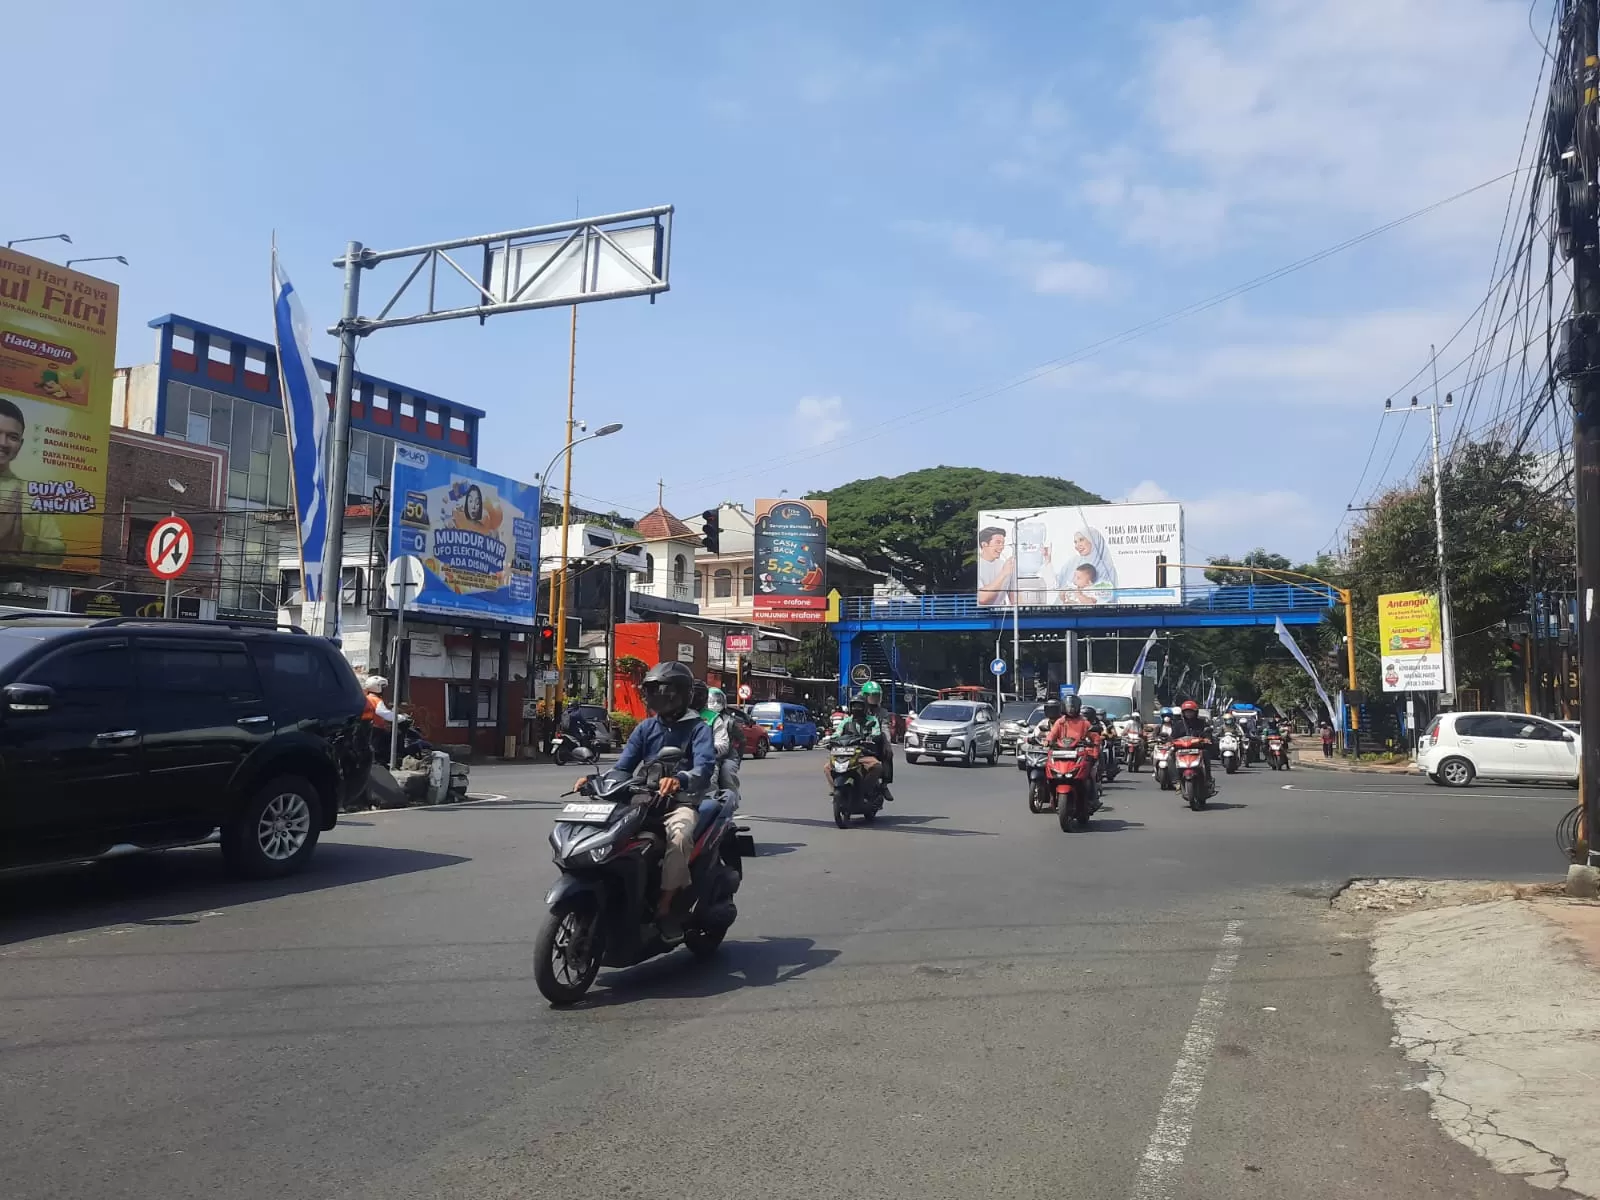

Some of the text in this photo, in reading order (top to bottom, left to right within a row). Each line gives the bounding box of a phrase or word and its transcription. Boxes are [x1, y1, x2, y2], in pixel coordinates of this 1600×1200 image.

[36, 268, 69, 288] Hari
[73, 280, 108, 301] Raya
[42, 286, 107, 327] Fitri
[4, 332, 73, 360] Hada Angin
[45, 426, 91, 441] ANGIN BUYAR
[44, 438, 98, 454] BADAN HANGAT
[43, 450, 86, 464] DAYA TAHAN
[409, 450, 426, 463] UFO
[43, 457, 97, 472] TUBUH TERJAGA
[28, 480, 76, 497] BUYAR
[1140, 524, 1154, 534] BAIK
[1156, 523, 1177, 533] UNTUK
[436, 530, 484, 548] MUNDUR
[486, 538, 507, 558] WIR
[773, 539, 798, 549] CASH
[1108, 536, 1124, 545] ANAK
[1126, 535, 1139, 544] DAN
[434, 546, 451, 556] UFO
[452, 547, 505, 568] ELEKTRONIKA
[773, 546, 795, 555] BACK
[450, 557, 489, 573] ADA DISINI
[1387, 598, 1429, 609] Antangin
[755, 610, 821, 619] KUNJUNGI erafone
